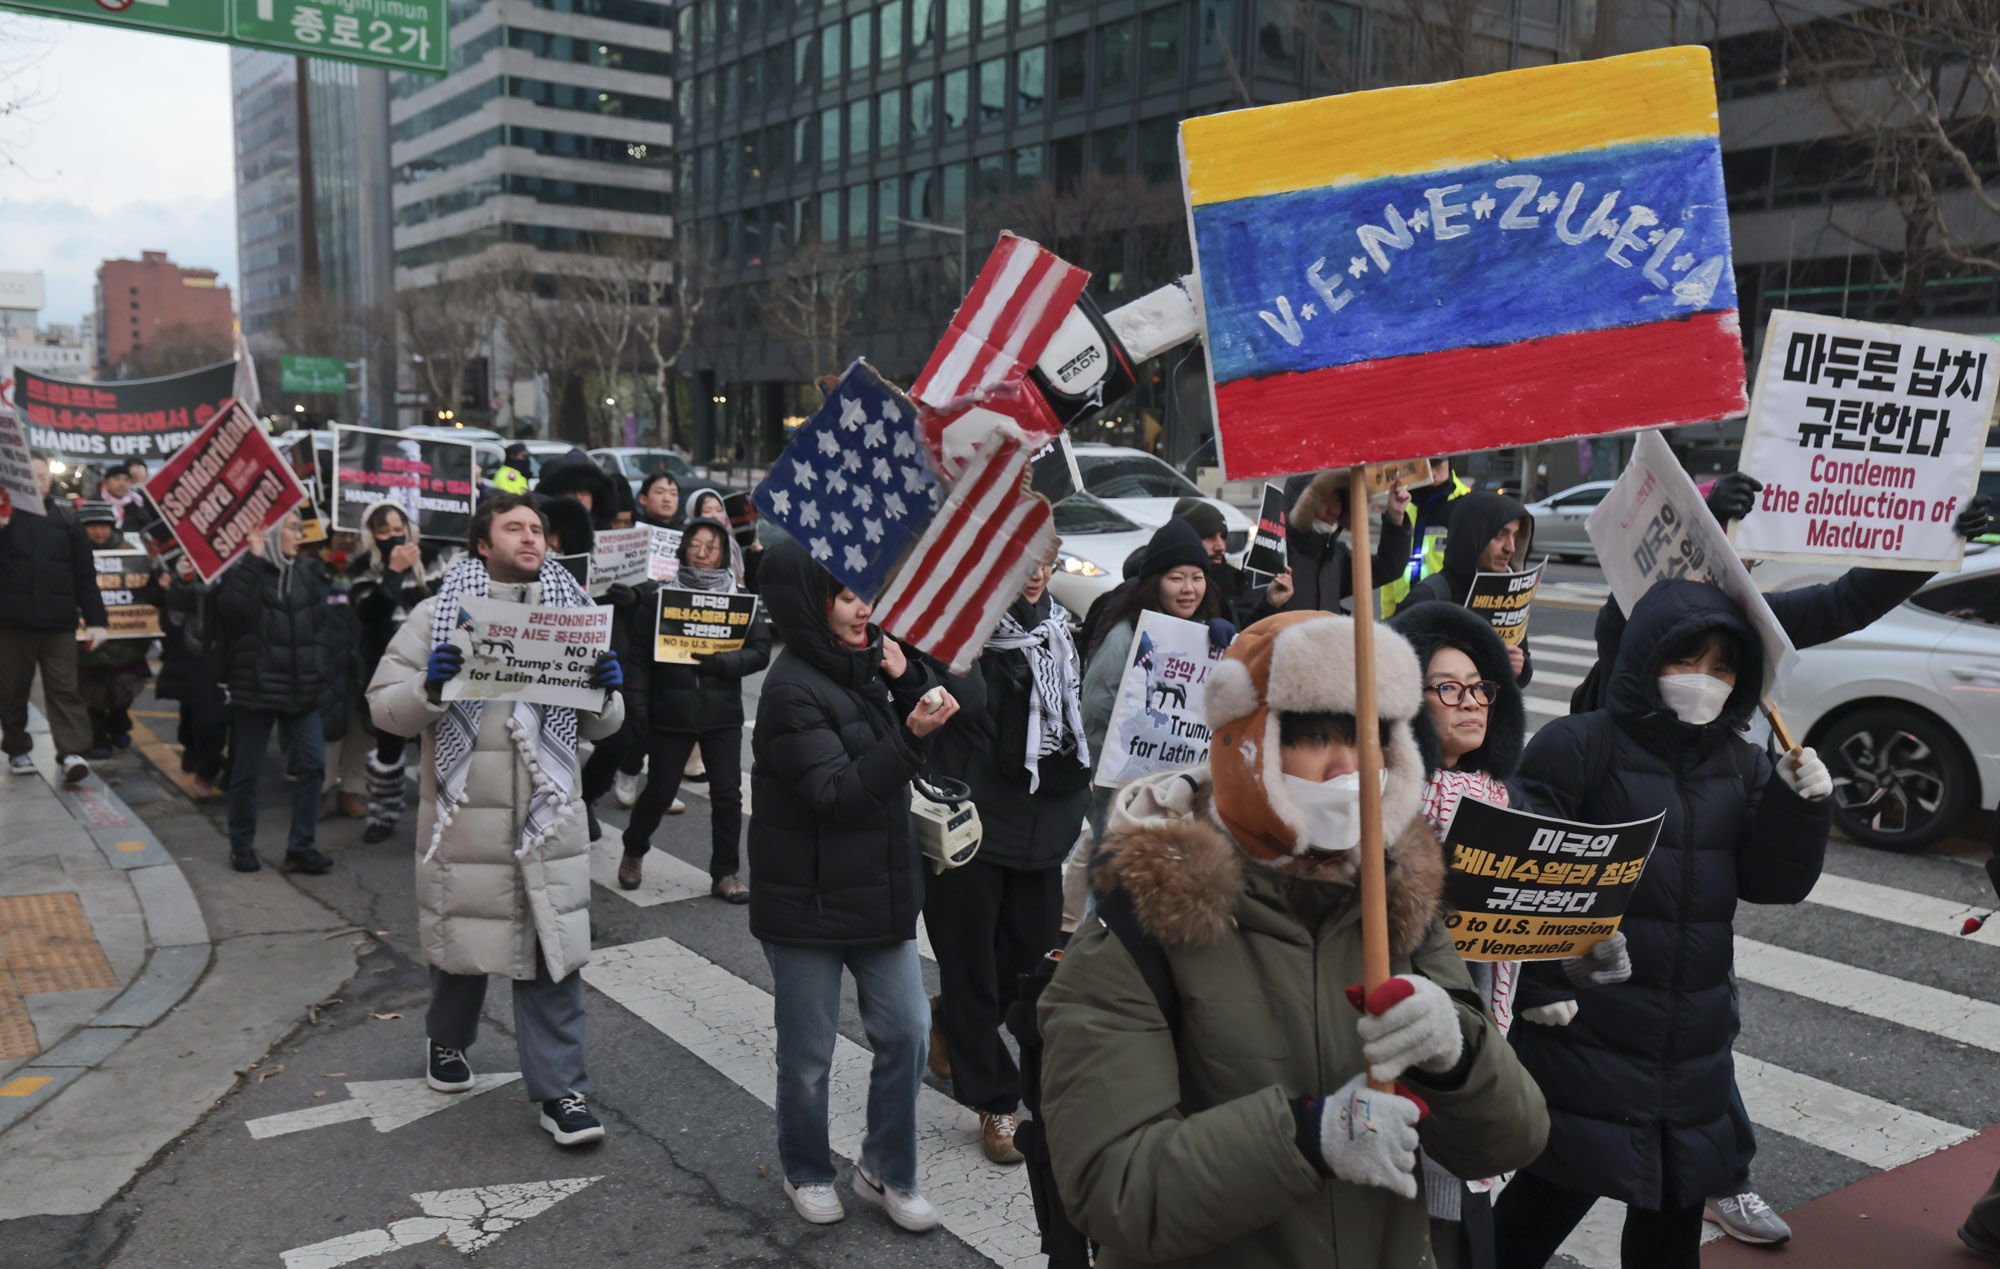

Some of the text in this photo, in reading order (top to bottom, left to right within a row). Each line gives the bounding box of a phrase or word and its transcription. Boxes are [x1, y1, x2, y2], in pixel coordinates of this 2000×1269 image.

[291, 6, 430, 61] 종로2가
[1783, 331, 1988, 402] 마두로 납치
[1798, 397, 1951, 457] 규탄한다
[30, 427, 107, 454] HANDS
[110, 435, 151, 454] OFF
[1810, 454, 1916, 489] Condemn
[190, 482, 235, 536] para
[213, 467, 285, 560] siempre!
[1762, 483, 1957, 522] the abduction of
[1256, 535, 1277, 551] HANDS
[1806, 519, 1904, 551] Maduro!
[625, 551, 638, 560] NO
[691, 594, 729, 609] 미국의
[529, 612, 608, 628] 라틴아메리카
[663, 606, 727, 624] 베네수엘라
[488, 624, 606, 645] 장악 시도 중단하라
[663, 638, 677, 646] NO
[680, 639, 689, 648] to
[691, 640, 710, 649] U.S.
[682, 623, 732, 638] 규탄한다
[505, 656, 593, 673] Trump's Gra
[564, 645, 588, 658] NO
[469, 669, 491, 681] for
[494, 671, 533, 684] Latin
[1164, 657, 1197, 683] 장악
[1130, 735, 1158, 759] for
[1159, 741, 1196, 764] Latin
[1528, 827, 1619, 857] 미국의
[1450, 844, 1646, 886] 베네수엘라 침공
[1486, 886, 1598, 913] 규탄한다
[1466, 917, 1487, 932] to
[1493, 918, 1531, 935] U.S.
[1536, 921, 1615, 936] invasion
[1455, 938, 1576, 956] of Venezuela
